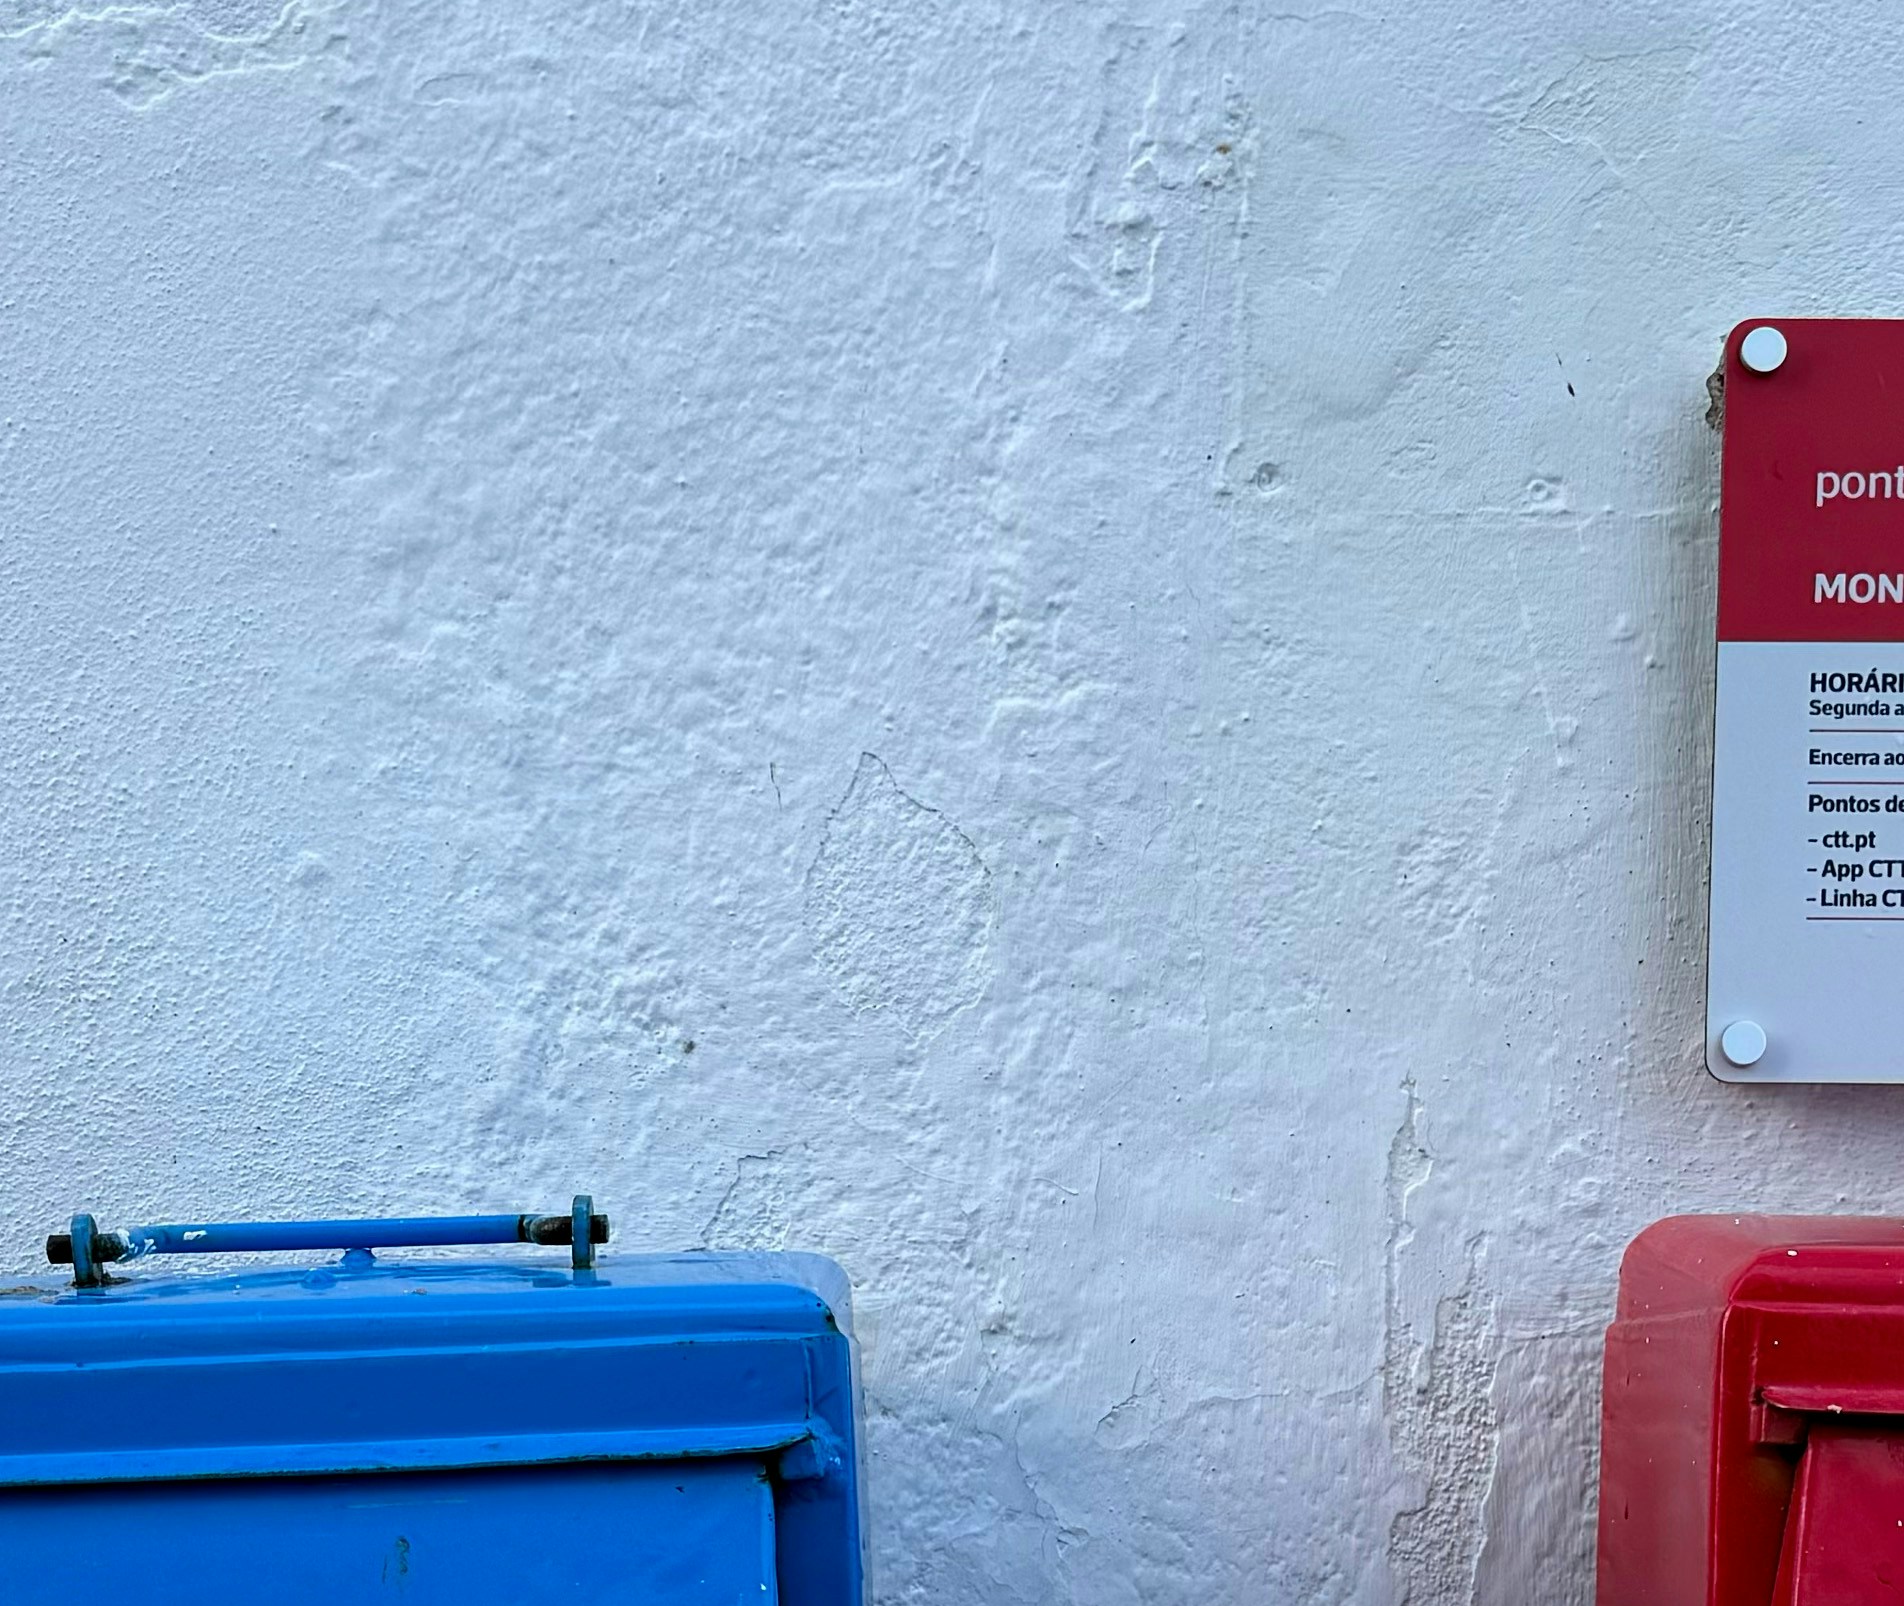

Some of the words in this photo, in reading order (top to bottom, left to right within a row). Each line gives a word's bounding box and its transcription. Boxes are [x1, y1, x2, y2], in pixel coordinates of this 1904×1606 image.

[1808, 699, 1891, 720] Segunda
[1894, 703, 1904, 716] a
[1809, 748, 1880, 766] Encerra
[1808, 794, 1881, 813] Pontos
[1822, 830, 1876, 853] ctt.pt
[1821, 859, 1864, 882] App
[1820, 888, 1877, 908] Linha
